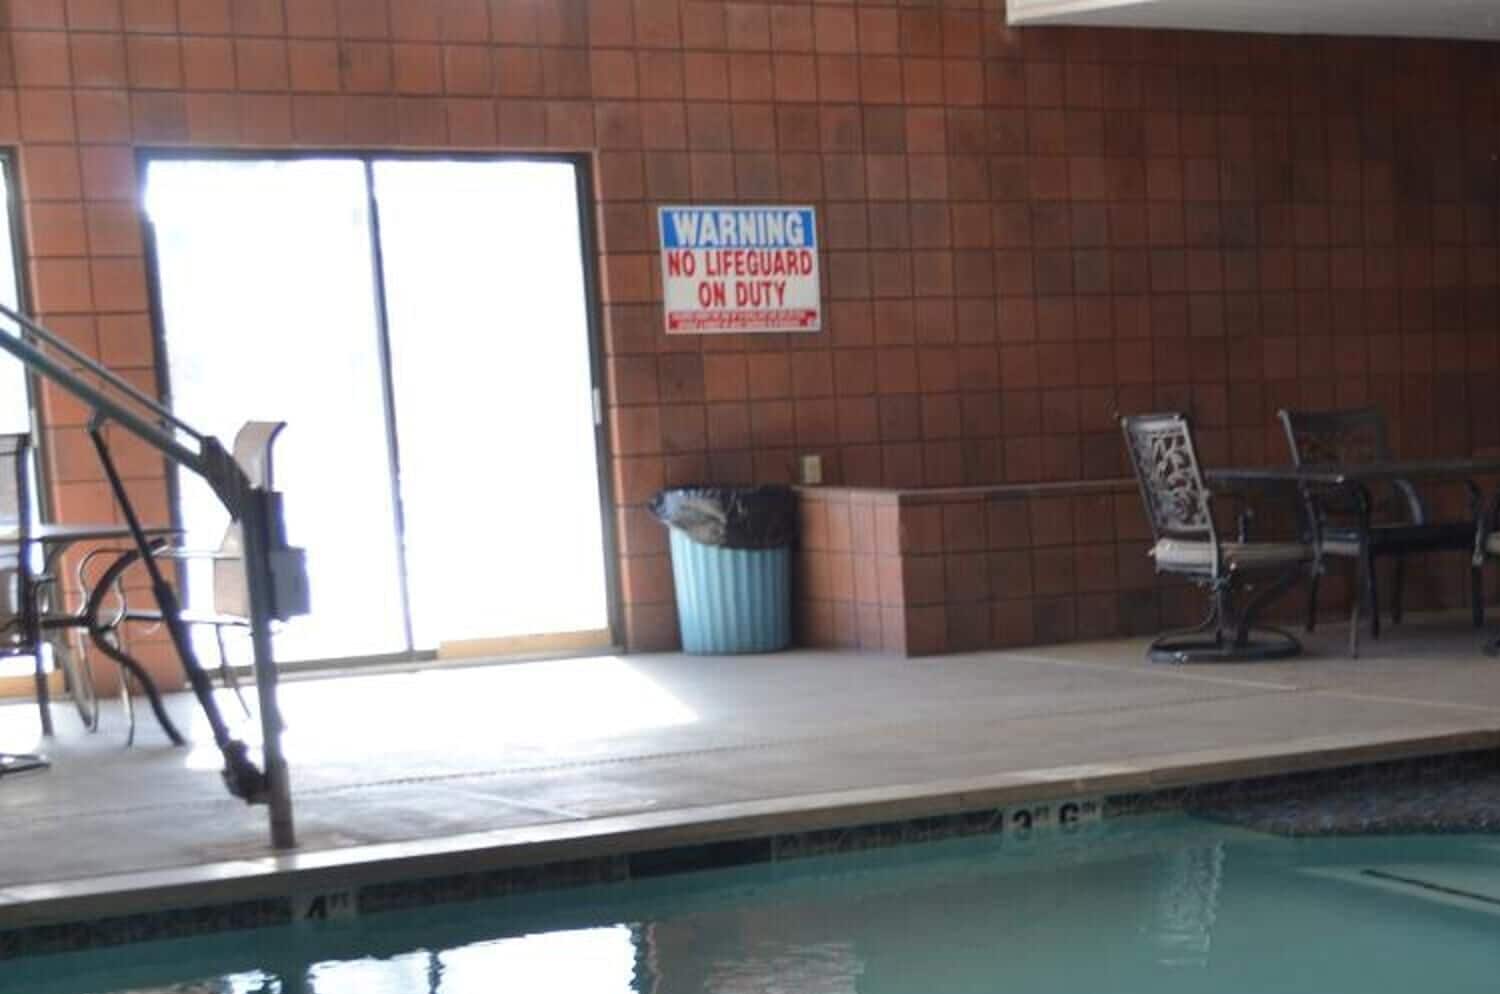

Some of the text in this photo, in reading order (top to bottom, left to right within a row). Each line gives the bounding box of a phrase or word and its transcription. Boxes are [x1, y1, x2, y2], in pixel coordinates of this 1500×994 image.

[671, 210, 805, 247] WARNING
[667, 250, 813, 277] NO LIFEGUARD
[698, 280, 787, 307] ON DUTY
